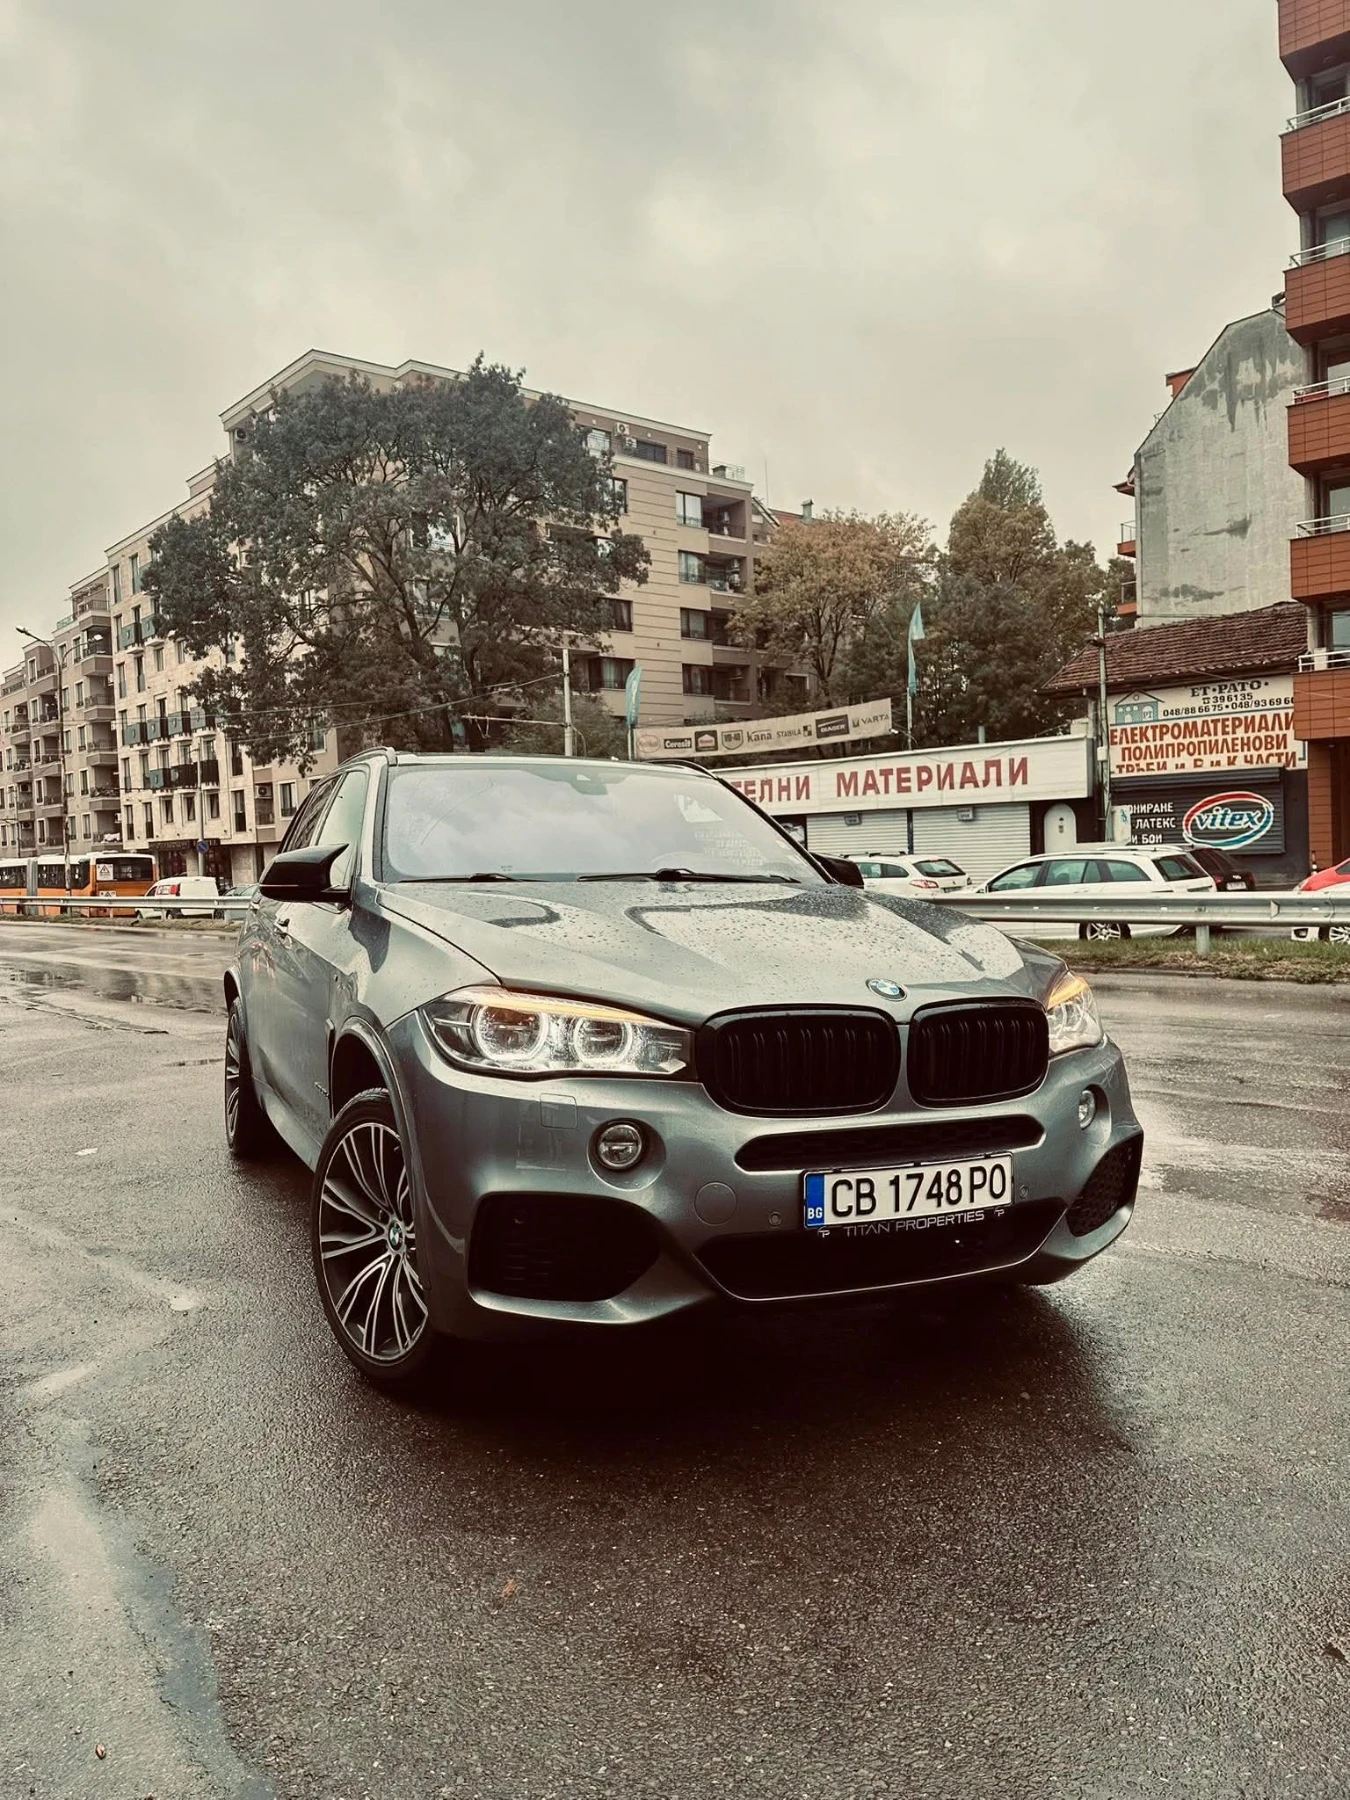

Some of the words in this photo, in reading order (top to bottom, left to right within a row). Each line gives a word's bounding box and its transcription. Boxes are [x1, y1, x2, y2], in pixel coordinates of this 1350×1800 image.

[861, 713, 890, 725] VARTA
[1110, 711, 1294, 746] ЕЛЕКТРОМАТЕРИАЛИ
[1121, 733, 1287, 762] ПОЛИПРОПИЛЕНОВИ
[836, 757, 1028, 798] МАТЕРИАЛИ
[1135, 817, 1176, 829] ЛАТЕКС
[1195, 805, 1262, 830] vitex
[831, 1178, 877, 1218] CB
[889, 1168, 963, 1214] 1748
[807, 1206, 824, 1219] BG
[843, 1221, 891, 1238] TITAN
[895, 1209, 986, 1232] PROPERTIES
